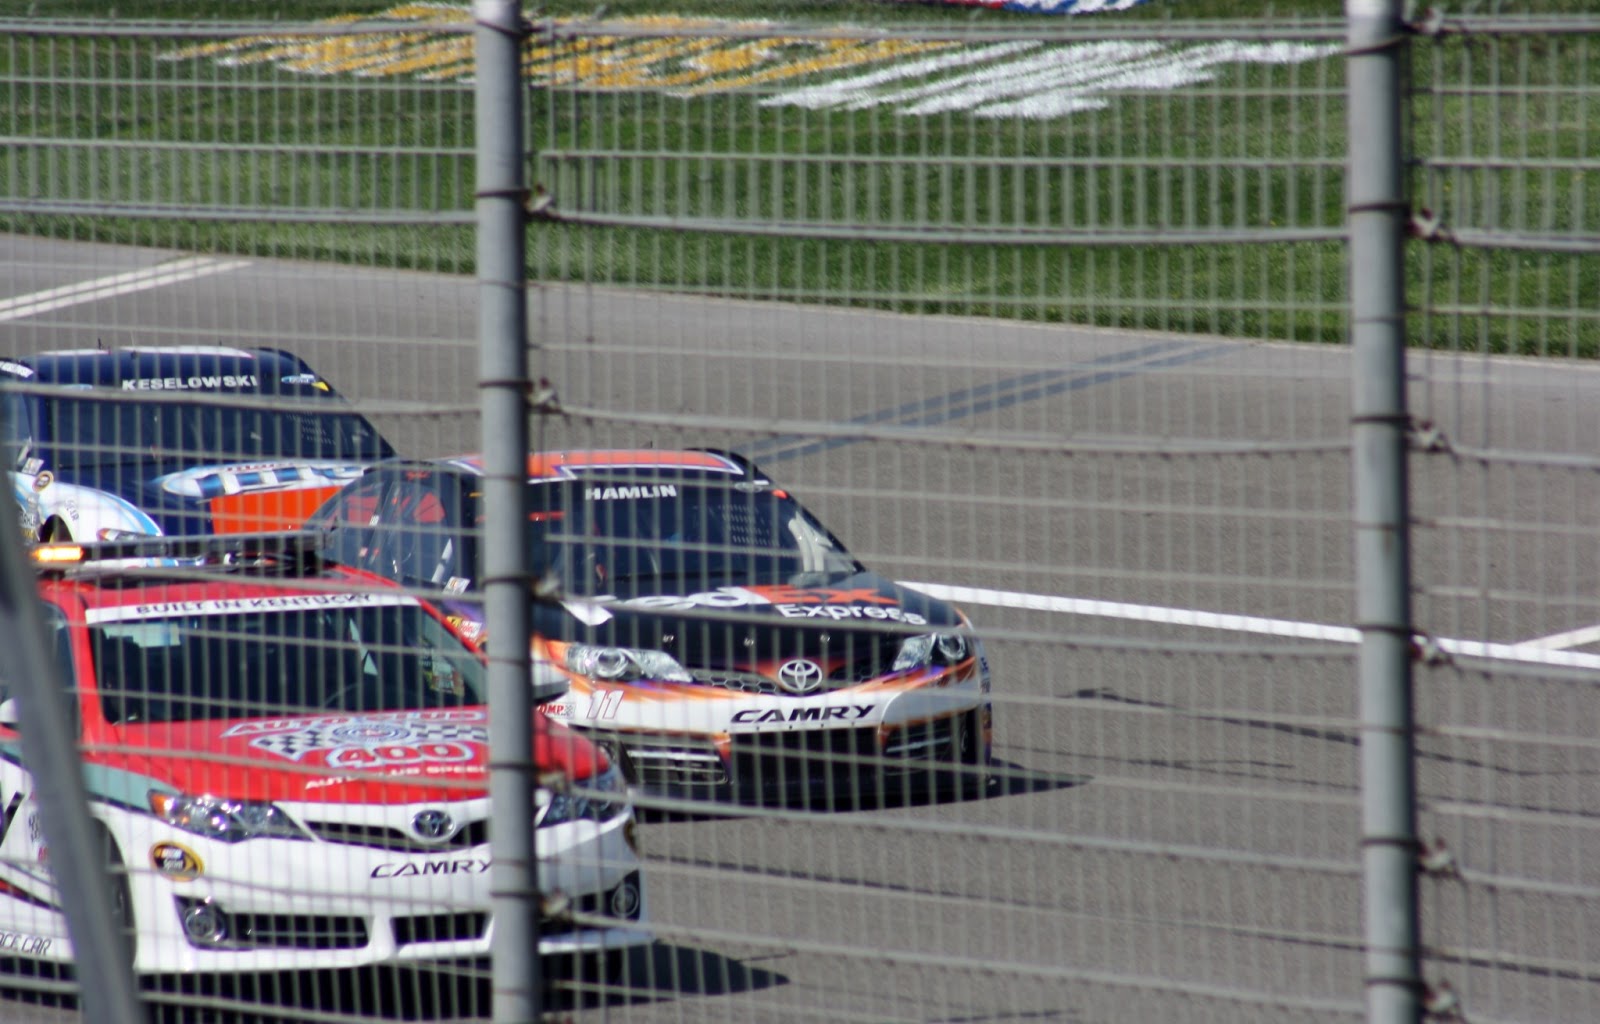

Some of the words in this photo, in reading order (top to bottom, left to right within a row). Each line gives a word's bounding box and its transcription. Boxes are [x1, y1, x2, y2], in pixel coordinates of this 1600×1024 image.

[122, 375, 258, 390] KESELOWSKI
[585, 485, 677, 500] HAMLIN
[136, 602, 204, 615] BUILT
[215, 600, 242, 610] IN
[250, 592, 372, 608] KENTUCKY
[775, 604, 927, 626] Express
[586, 690, 624, 719] 11
[731, 705, 875, 723] CAMRY
[326, 742, 474, 768] 400
[370, 859, 491, 878] CAMRY
[22, 935, 52, 955] CAR
